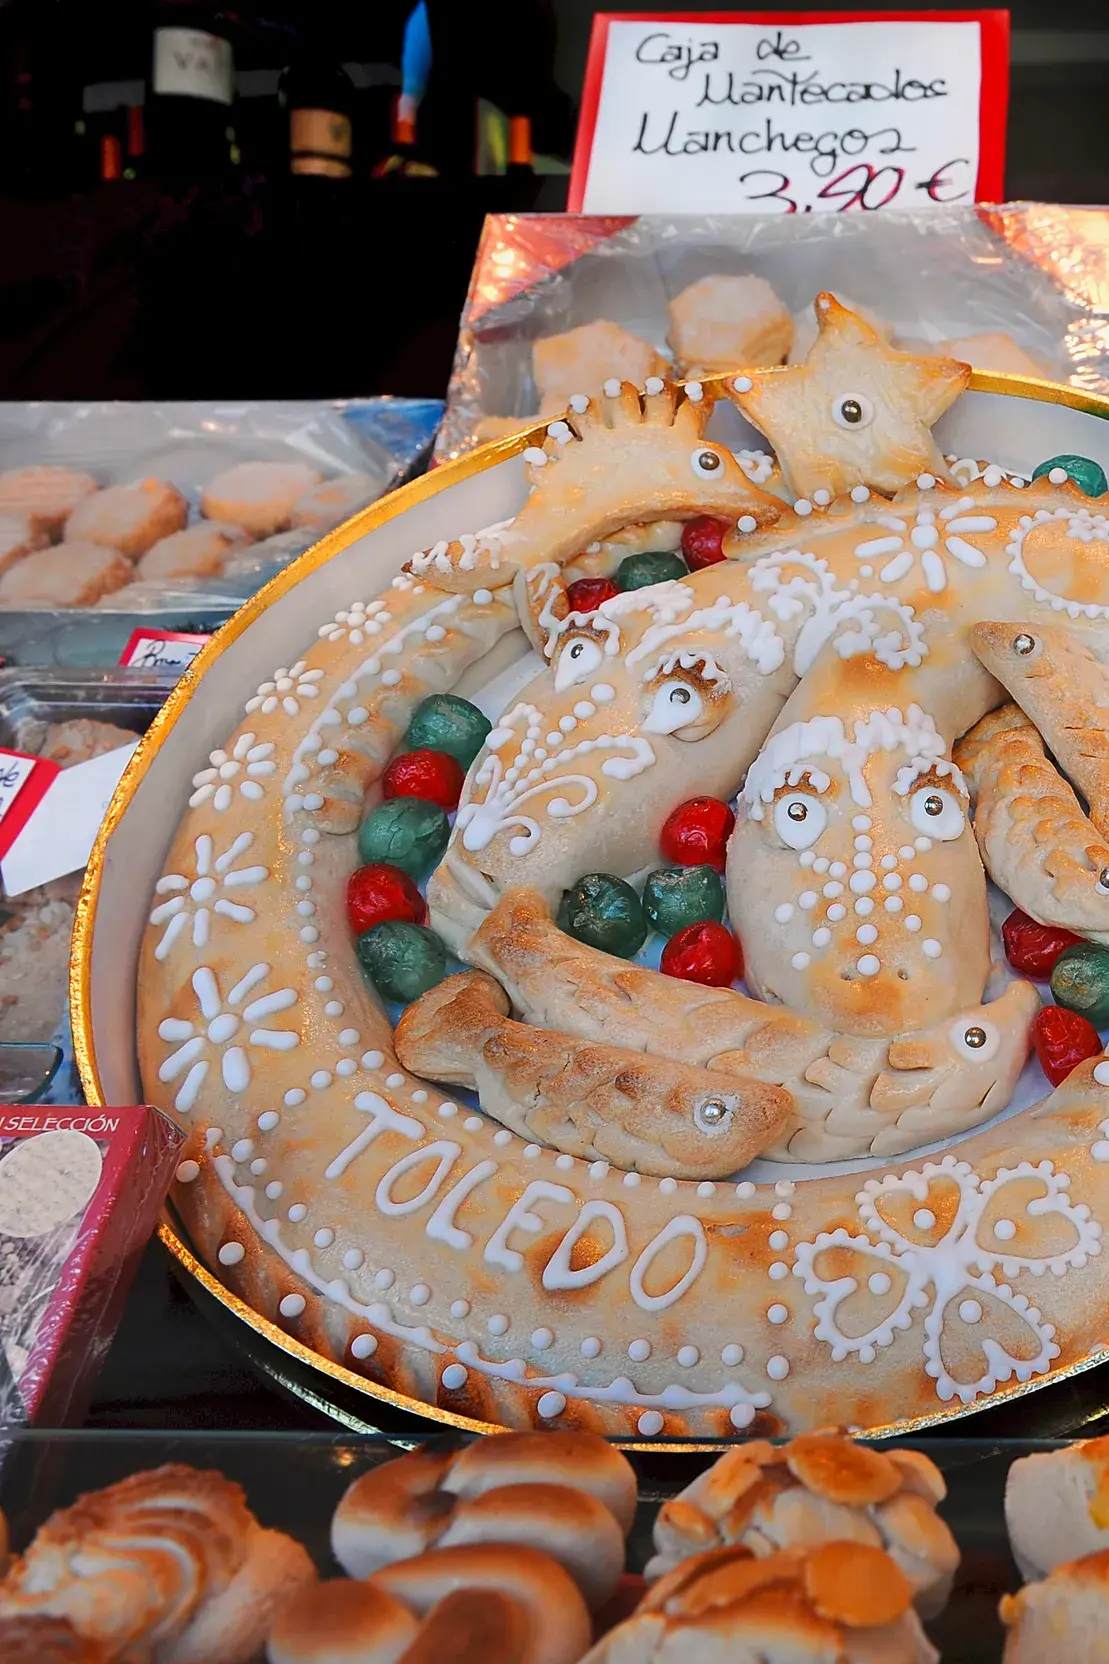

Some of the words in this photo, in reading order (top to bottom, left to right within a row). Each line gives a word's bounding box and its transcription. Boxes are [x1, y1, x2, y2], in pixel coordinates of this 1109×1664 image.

[635, 33, 720, 80] Caja
[757, 31, 811, 61] de
[697, 68, 948, 107] Mantecados
[632, 111, 916, 176] Manchegos
[3, 1113, 120, 1132] SELECCIÓN
[325, 1090, 708, 1312] TOLEDO
